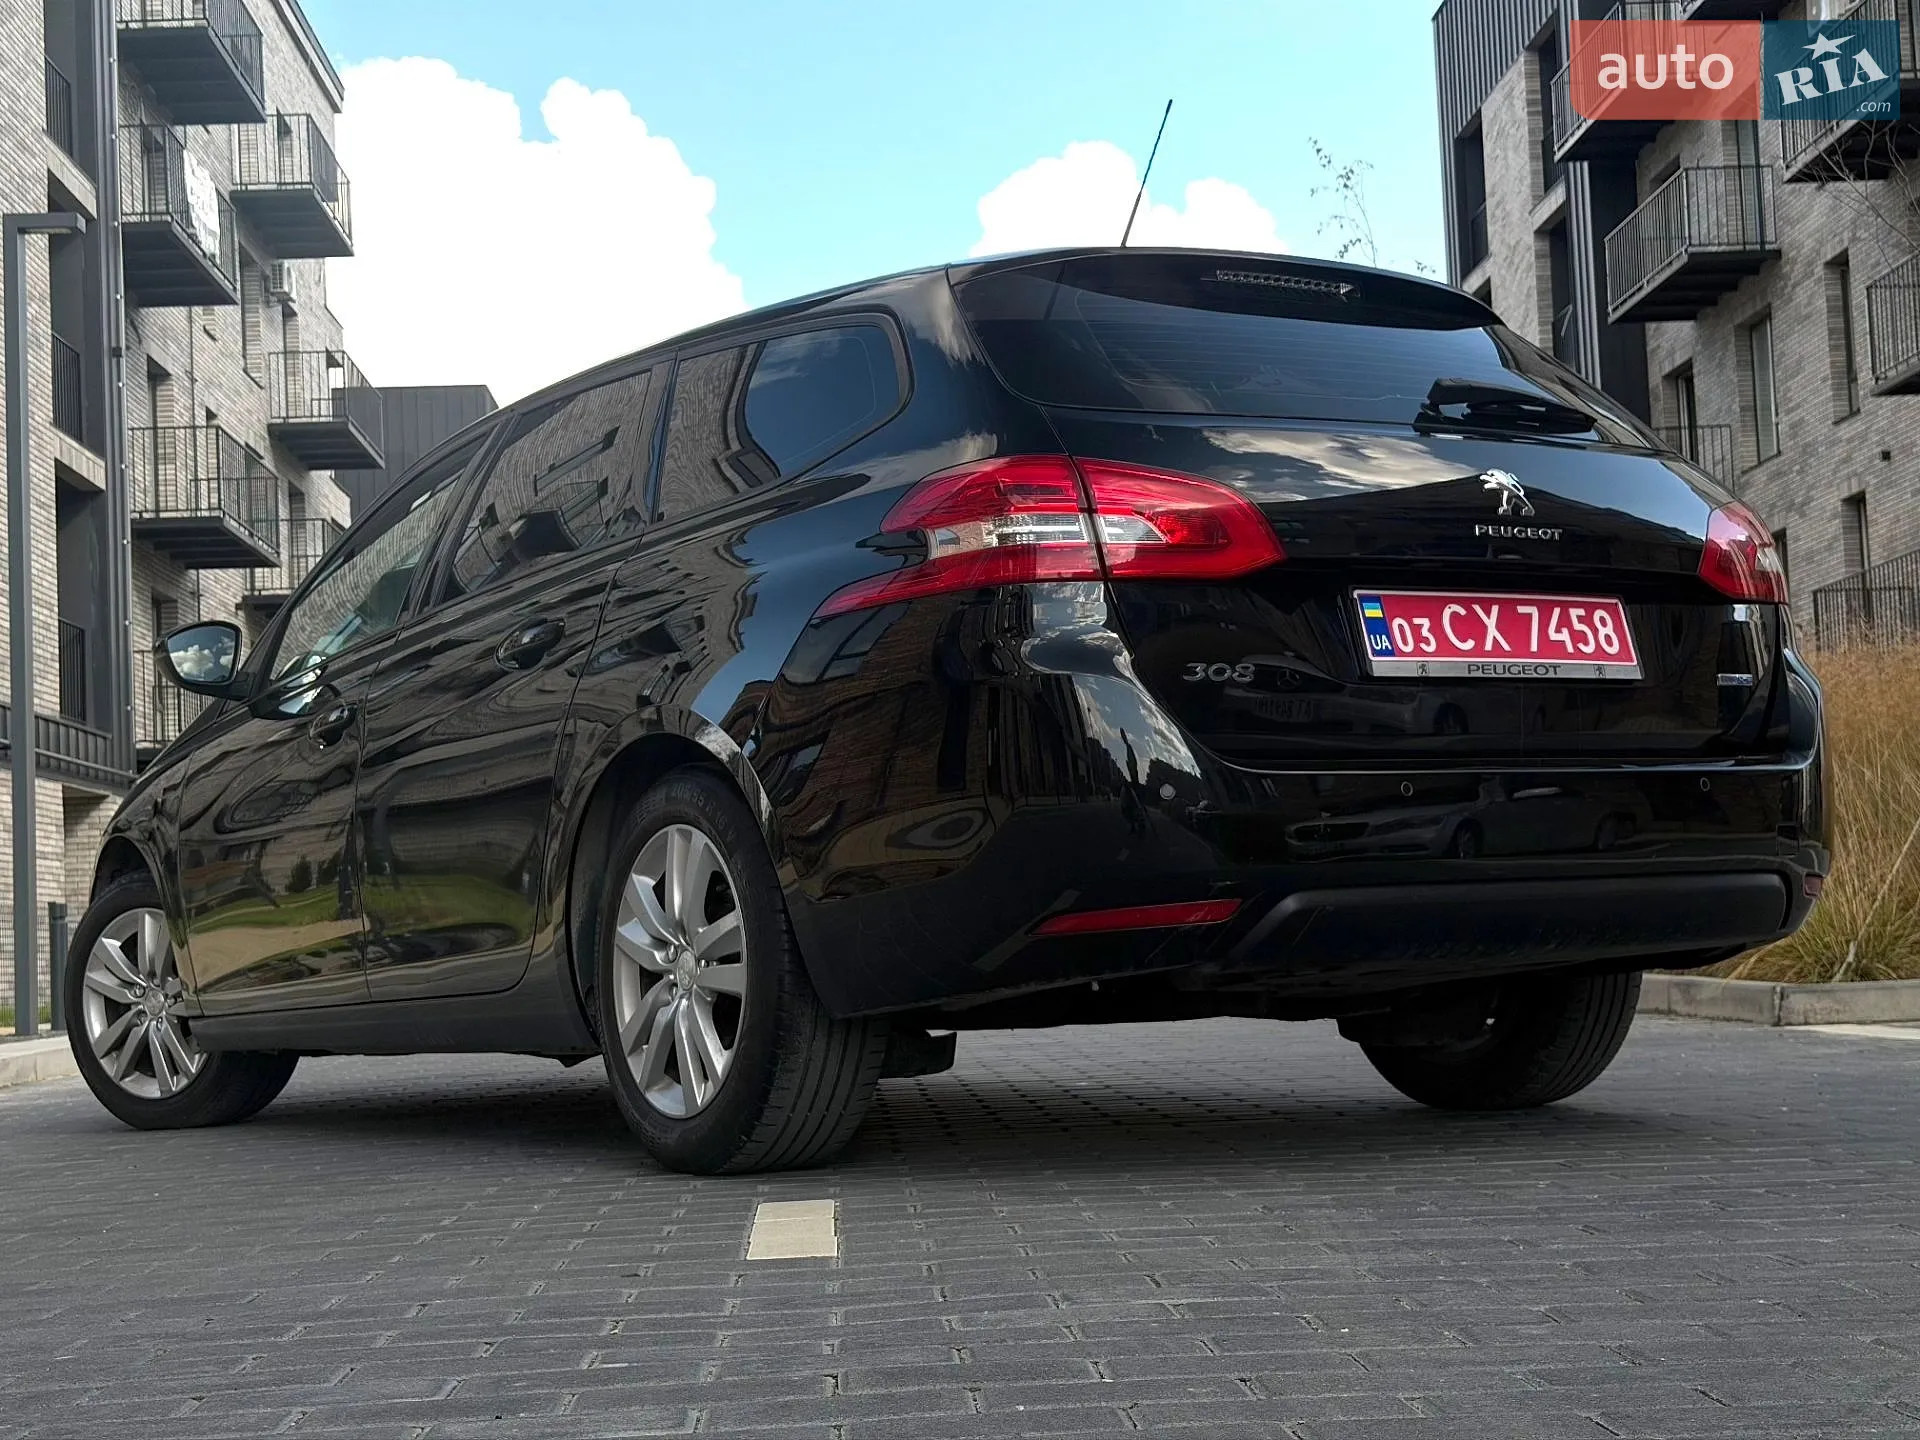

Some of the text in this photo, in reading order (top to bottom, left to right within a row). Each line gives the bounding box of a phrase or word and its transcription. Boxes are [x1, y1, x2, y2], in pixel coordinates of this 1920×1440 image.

[1475, 524, 1562, 540] PEUGEOT
[1392, 603, 1620, 655] 03 CX 7458
[1372, 634, 1392, 650] UA
[1182, 662, 1256, 682] 308
[1467, 663, 1562, 676] PEUGEOT
